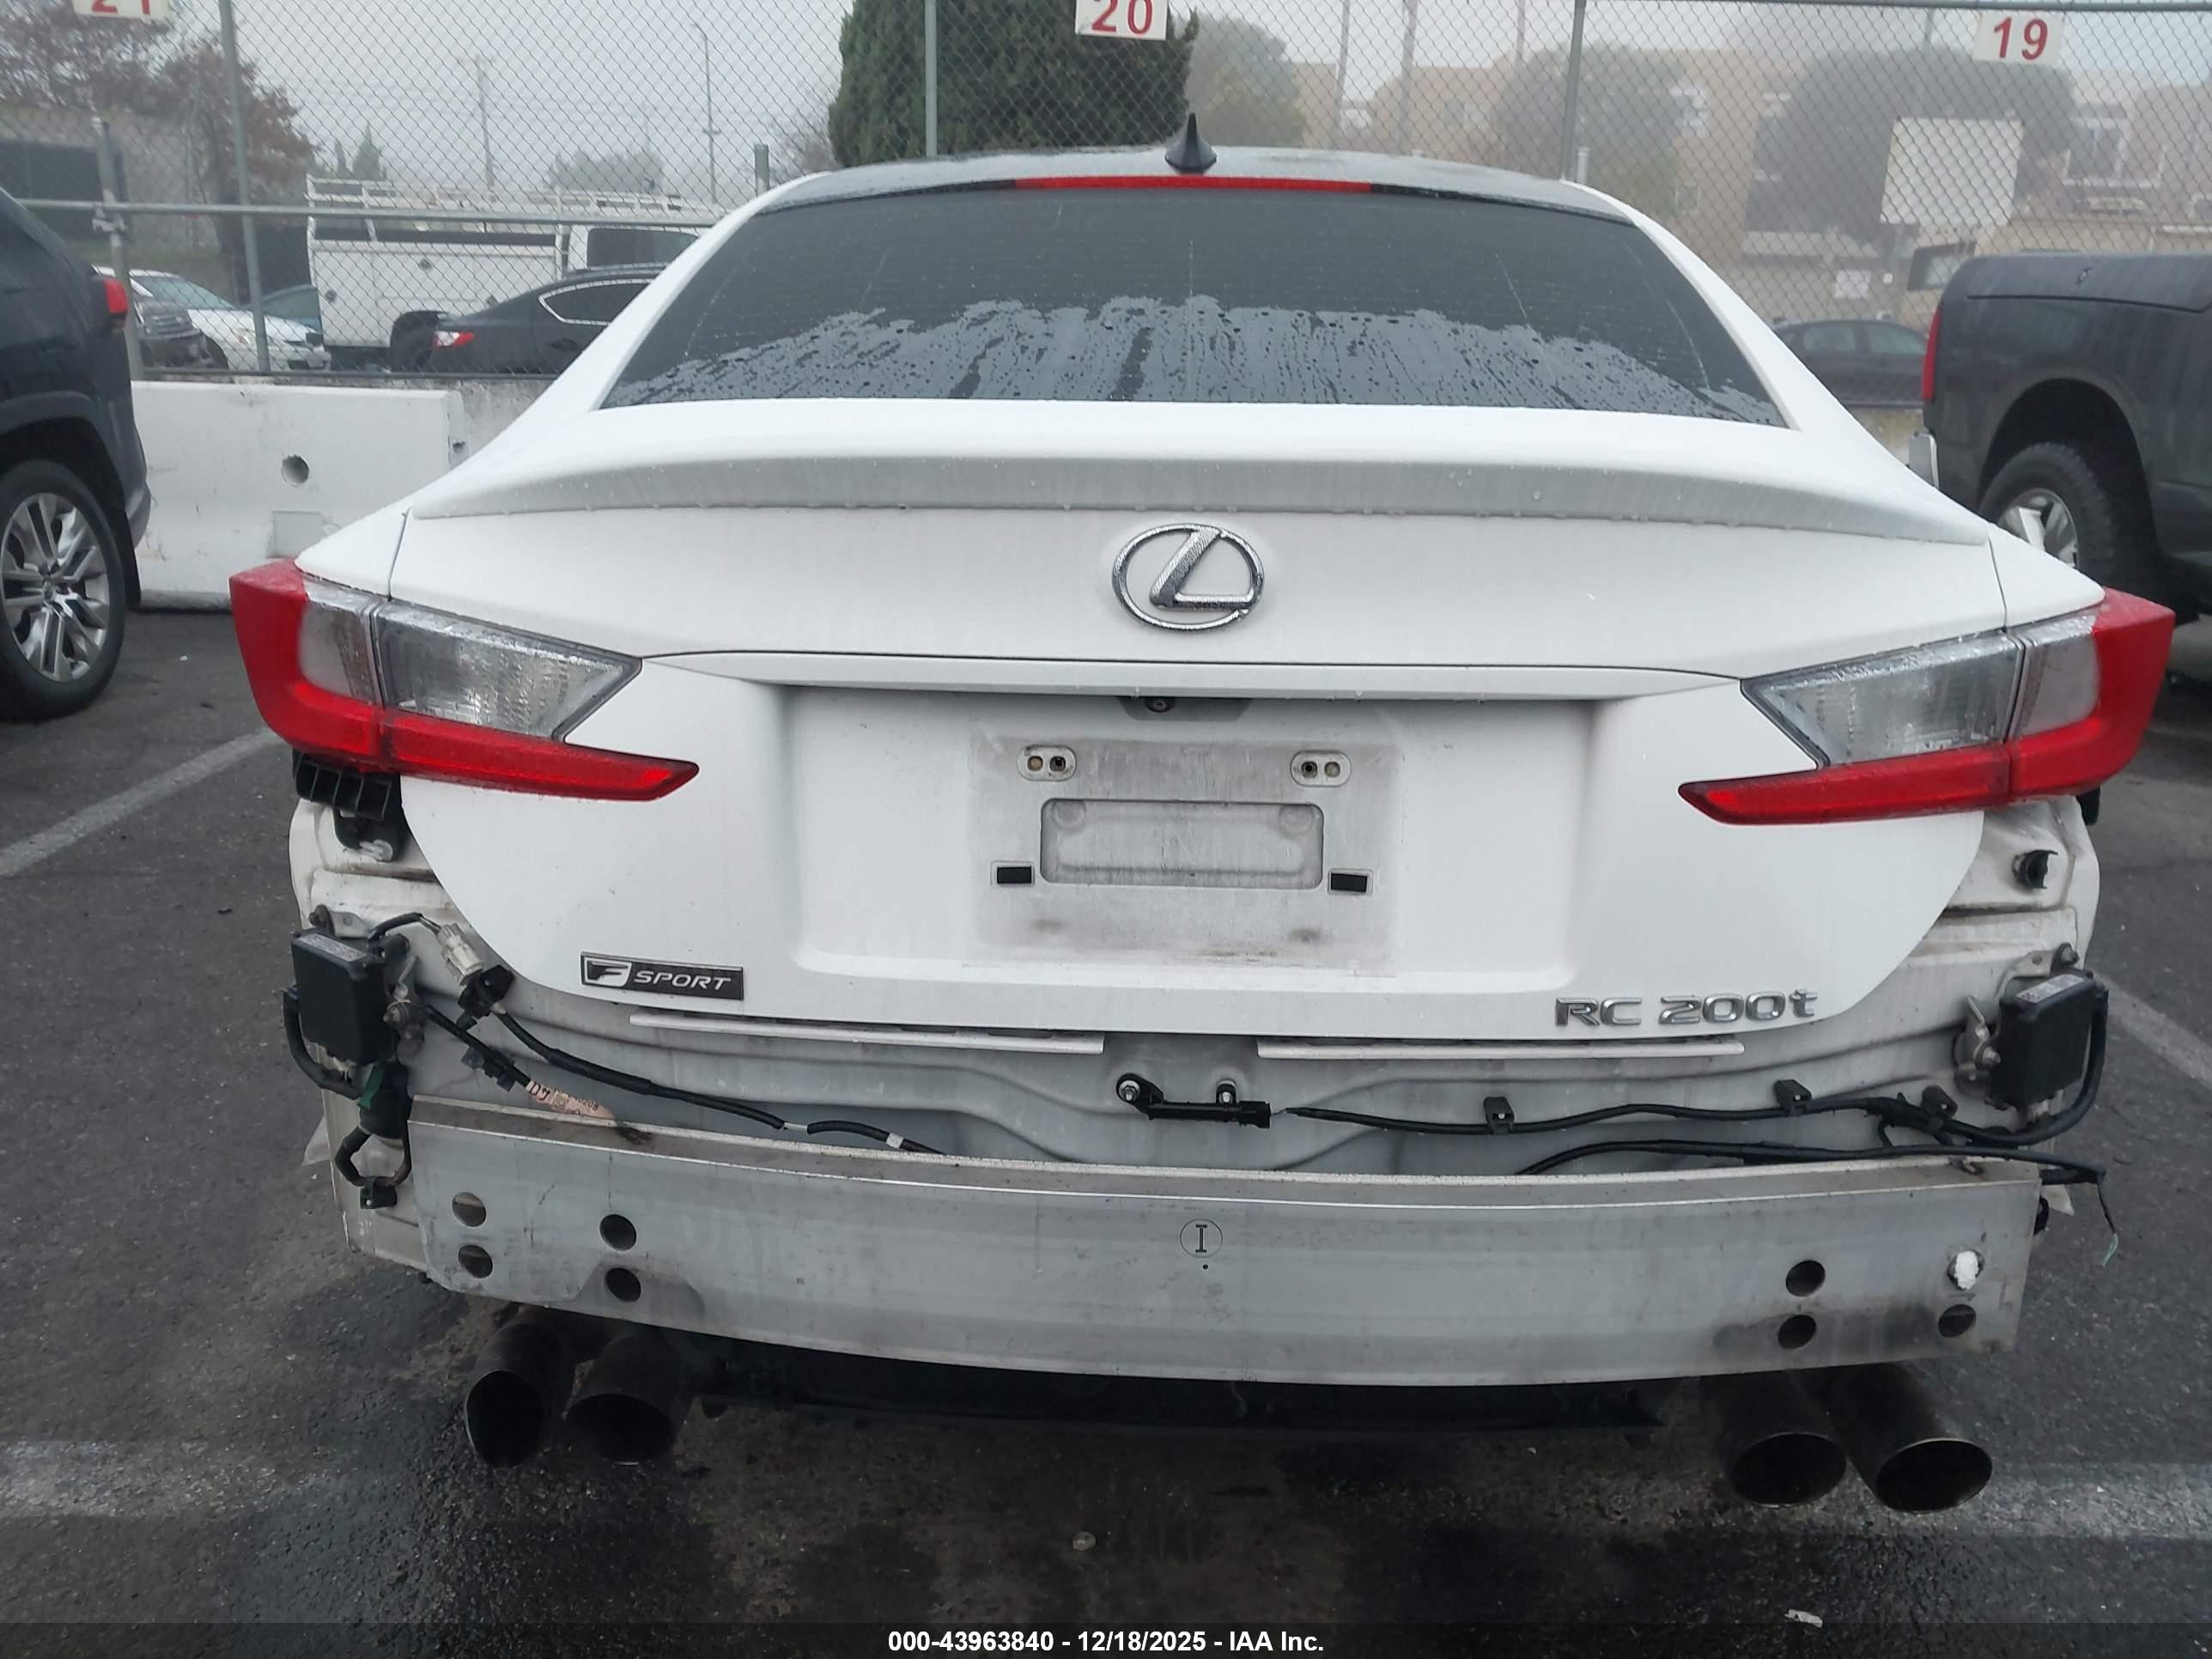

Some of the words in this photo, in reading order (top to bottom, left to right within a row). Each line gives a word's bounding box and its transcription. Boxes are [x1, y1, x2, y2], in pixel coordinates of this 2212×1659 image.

[1091, 0, 1153, 34] 20
[1993, 16, 2049, 61] 19
[634, 969, 732, 992] SPORT
[1555, 996, 1643, 1027] RC
[1657, 988, 1818, 1026] 200t
